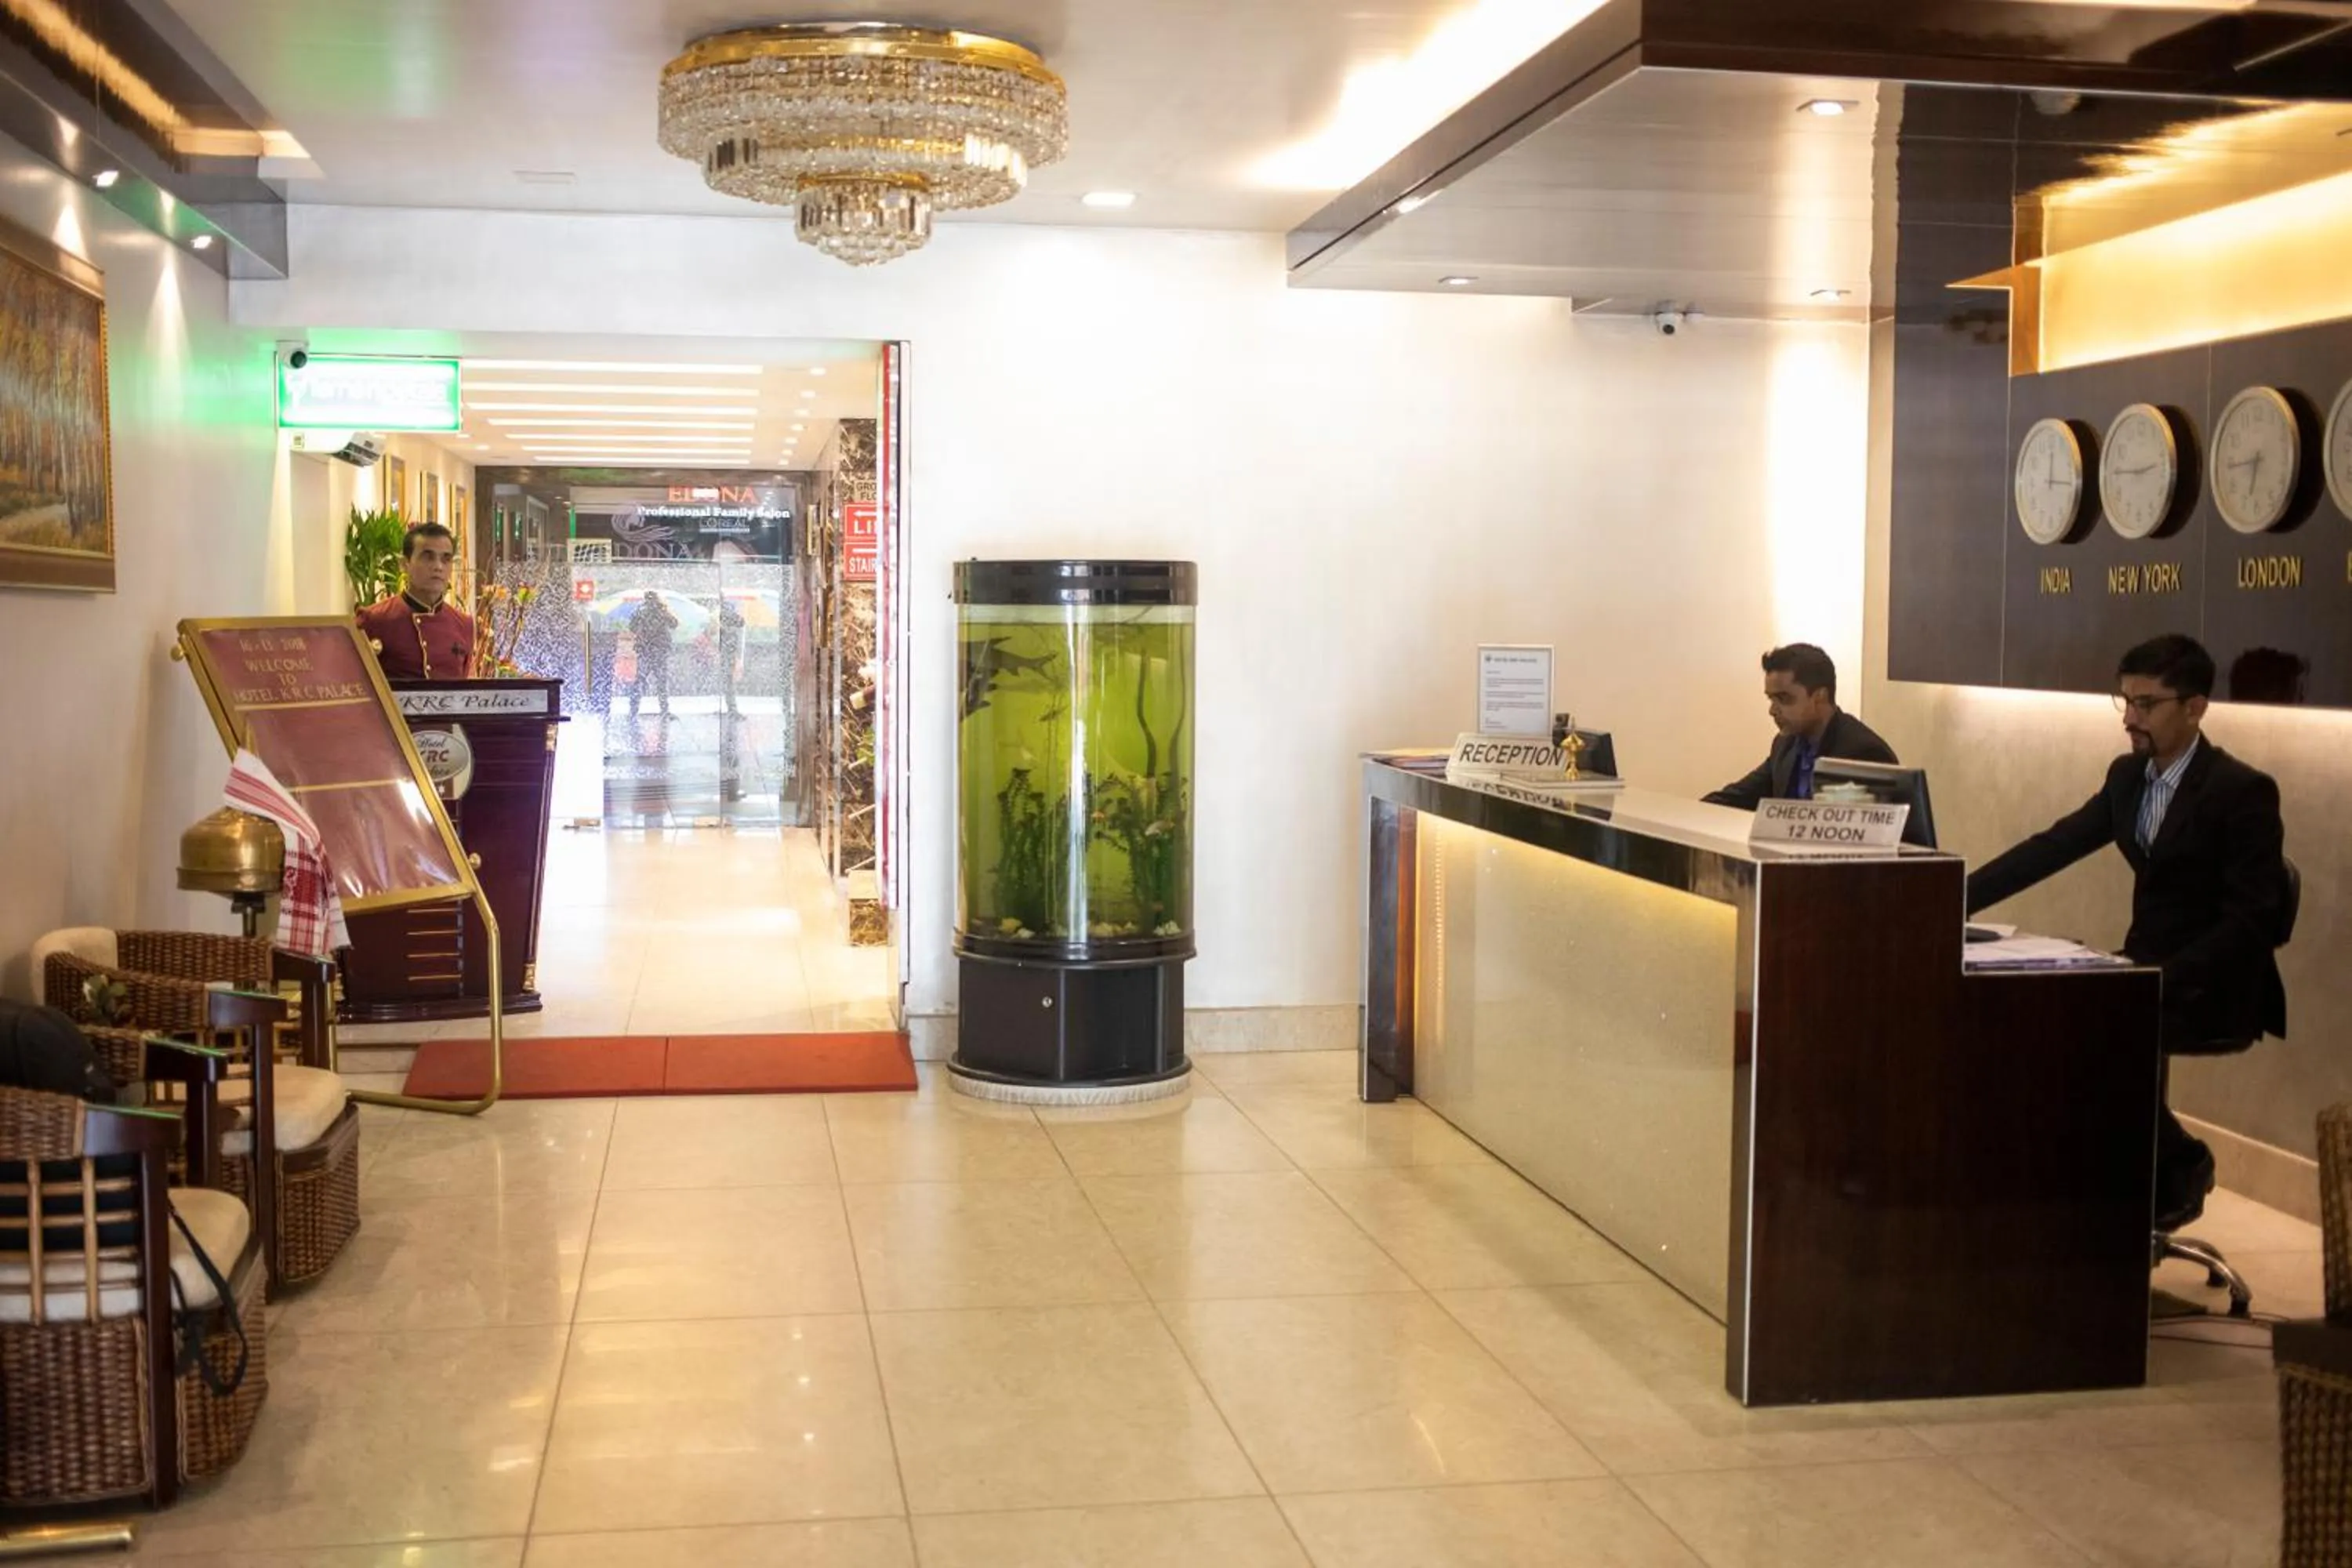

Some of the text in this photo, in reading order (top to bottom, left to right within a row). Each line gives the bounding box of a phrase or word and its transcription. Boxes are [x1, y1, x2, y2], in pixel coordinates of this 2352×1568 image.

[669, 485, 760, 504] ELNA
[637, 506, 710, 517] Professional
[713, 506, 753, 521] Family
[853, 519, 877, 535] LI
[2040, 566, 2072, 594] INDIA
[2108, 561, 2183, 594] NEW YORK
[2237, 556, 2302, 590] LONDON
[245, 657, 314, 673] WELCOME
[278, 673, 297, 686] TO
[234, 688, 278, 703] HOTEL
[314, 681, 366, 699] PALACE
[399, 694, 531, 712] KRC Palace
[1460, 742, 1565, 767] RECEPTION
[1766, 805, 1896, 826] CHECK OUT TIME
[1788, 825, 1867, 841] 12 NOON
